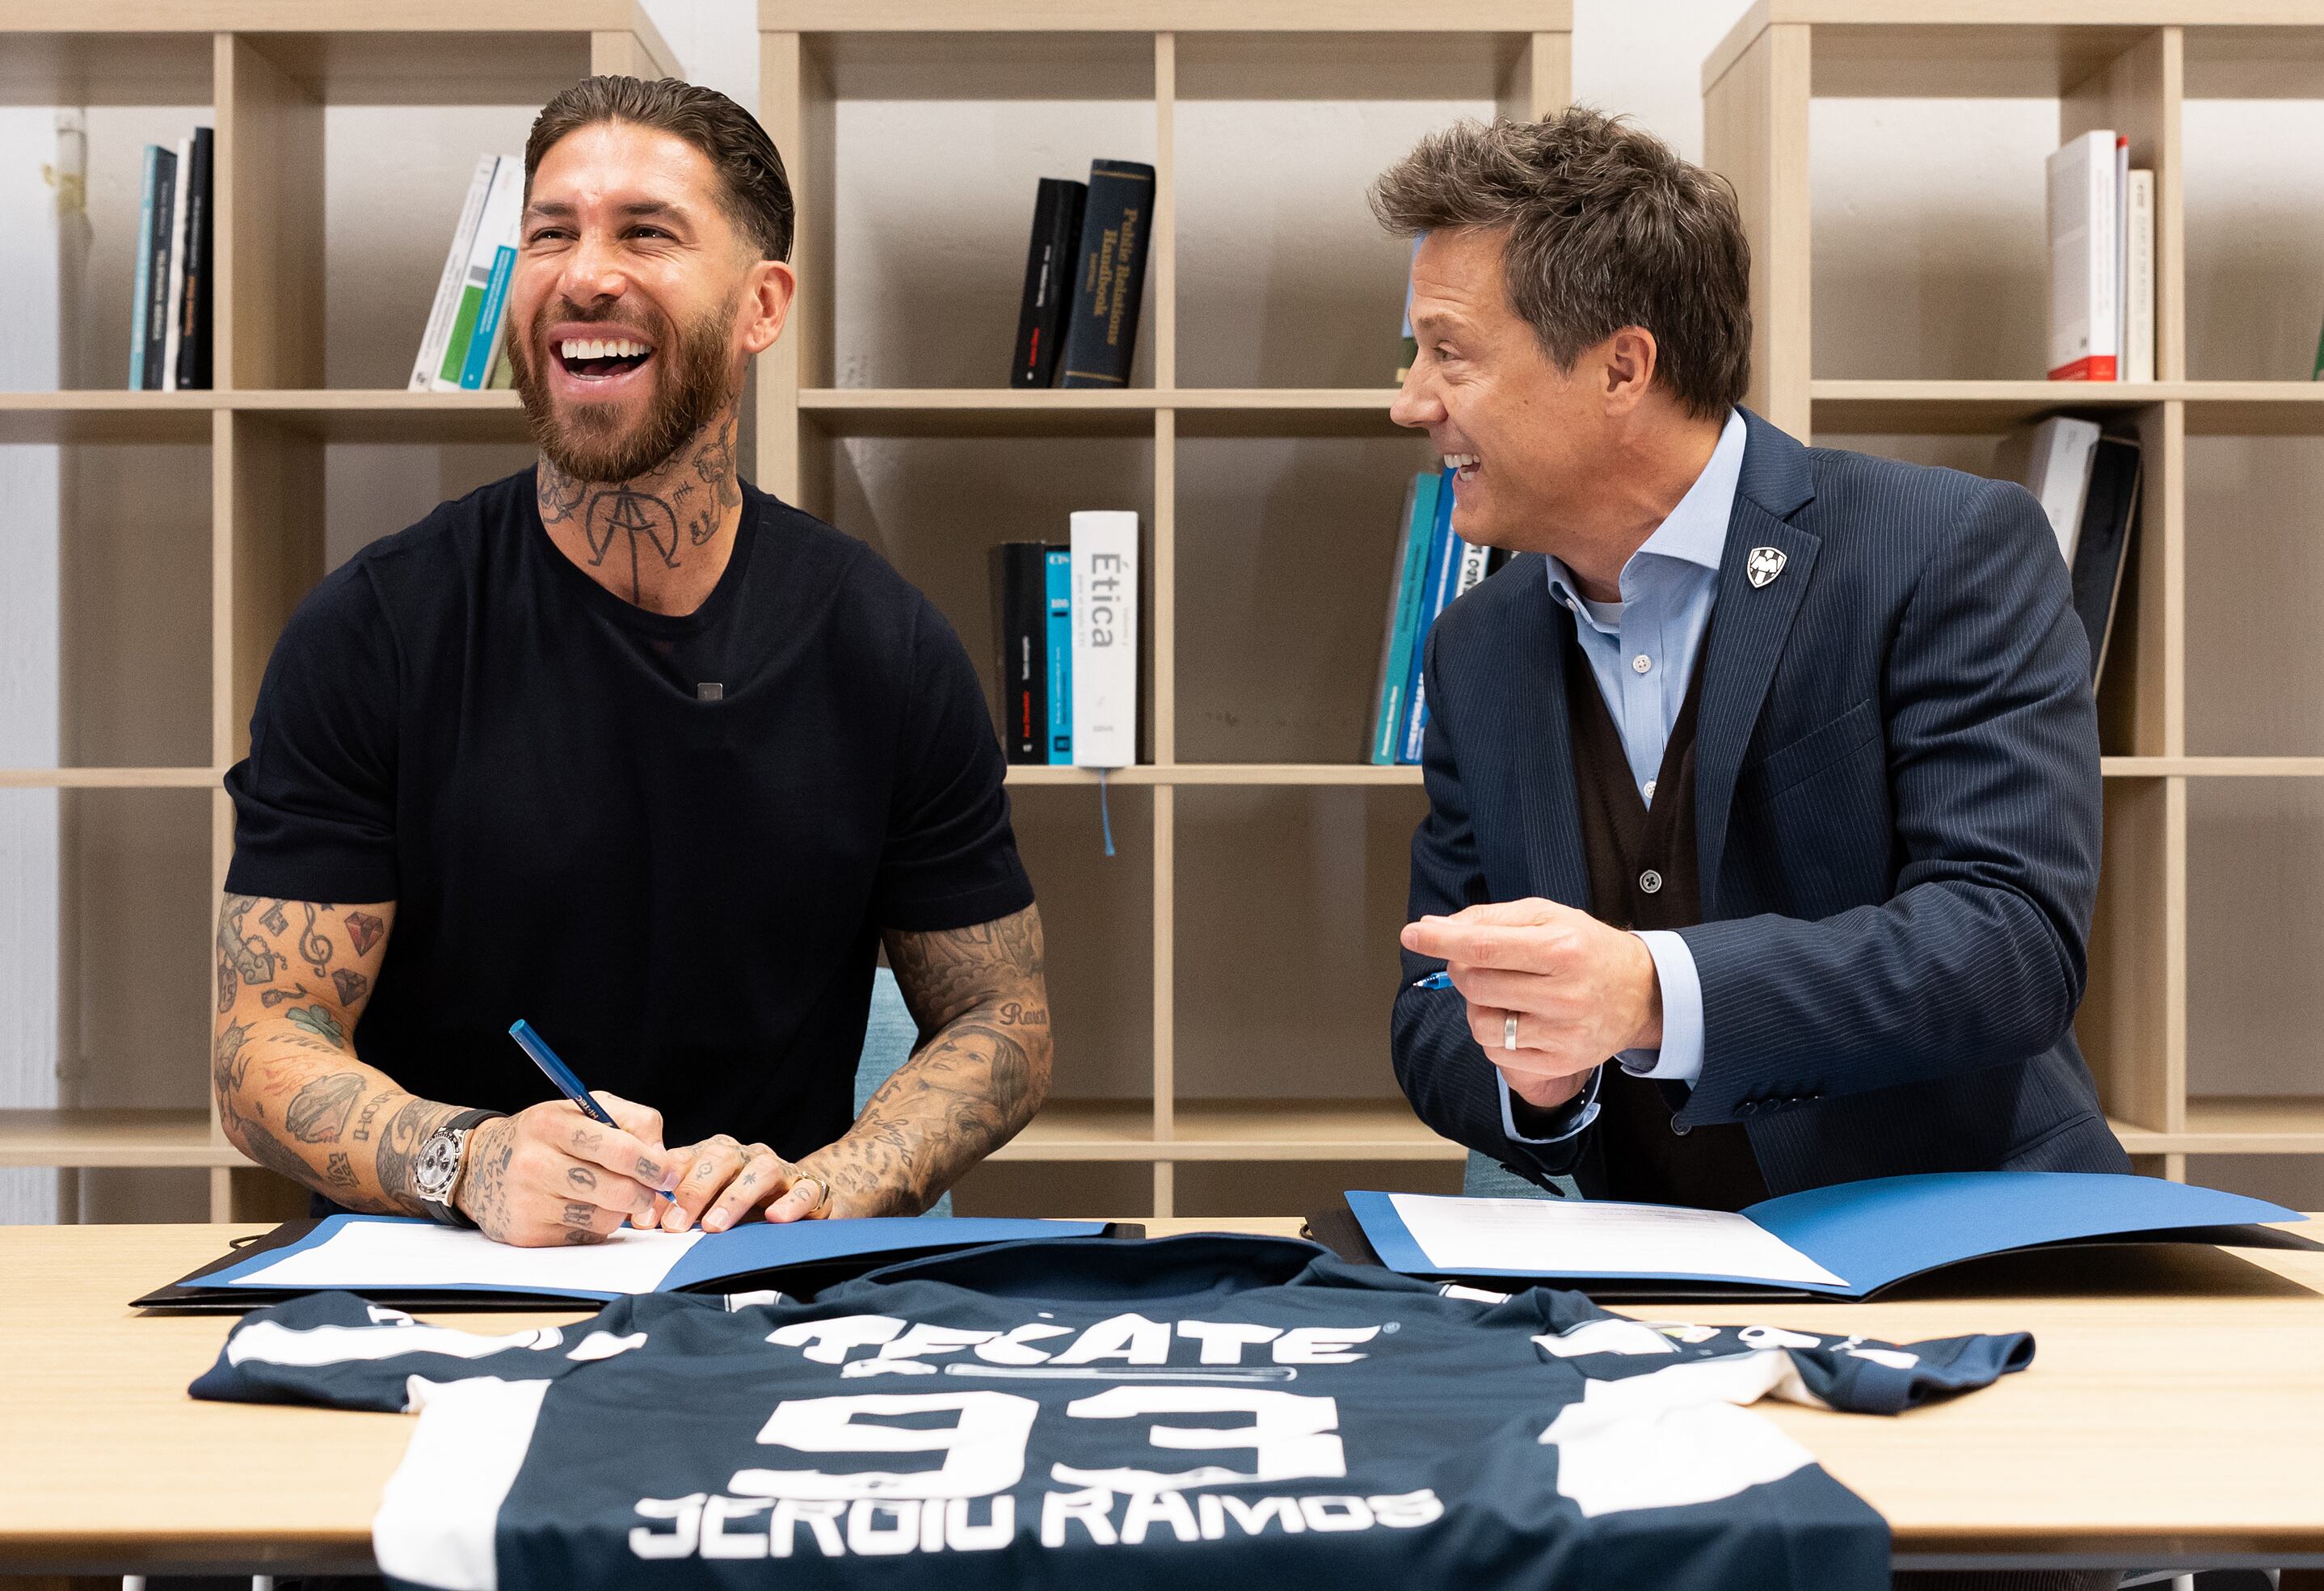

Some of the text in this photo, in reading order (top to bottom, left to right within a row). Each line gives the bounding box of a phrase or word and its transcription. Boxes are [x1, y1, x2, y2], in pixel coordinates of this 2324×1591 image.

[1094, 229, 1118, 316] Handbook
[1092, 553, 1129, 647] Ética
[764, 1312, 1383, 1366] TECATE
[728, 1385, 1347, 1501] 93
[1040, 1488, 1445, 1548] RAMOS
